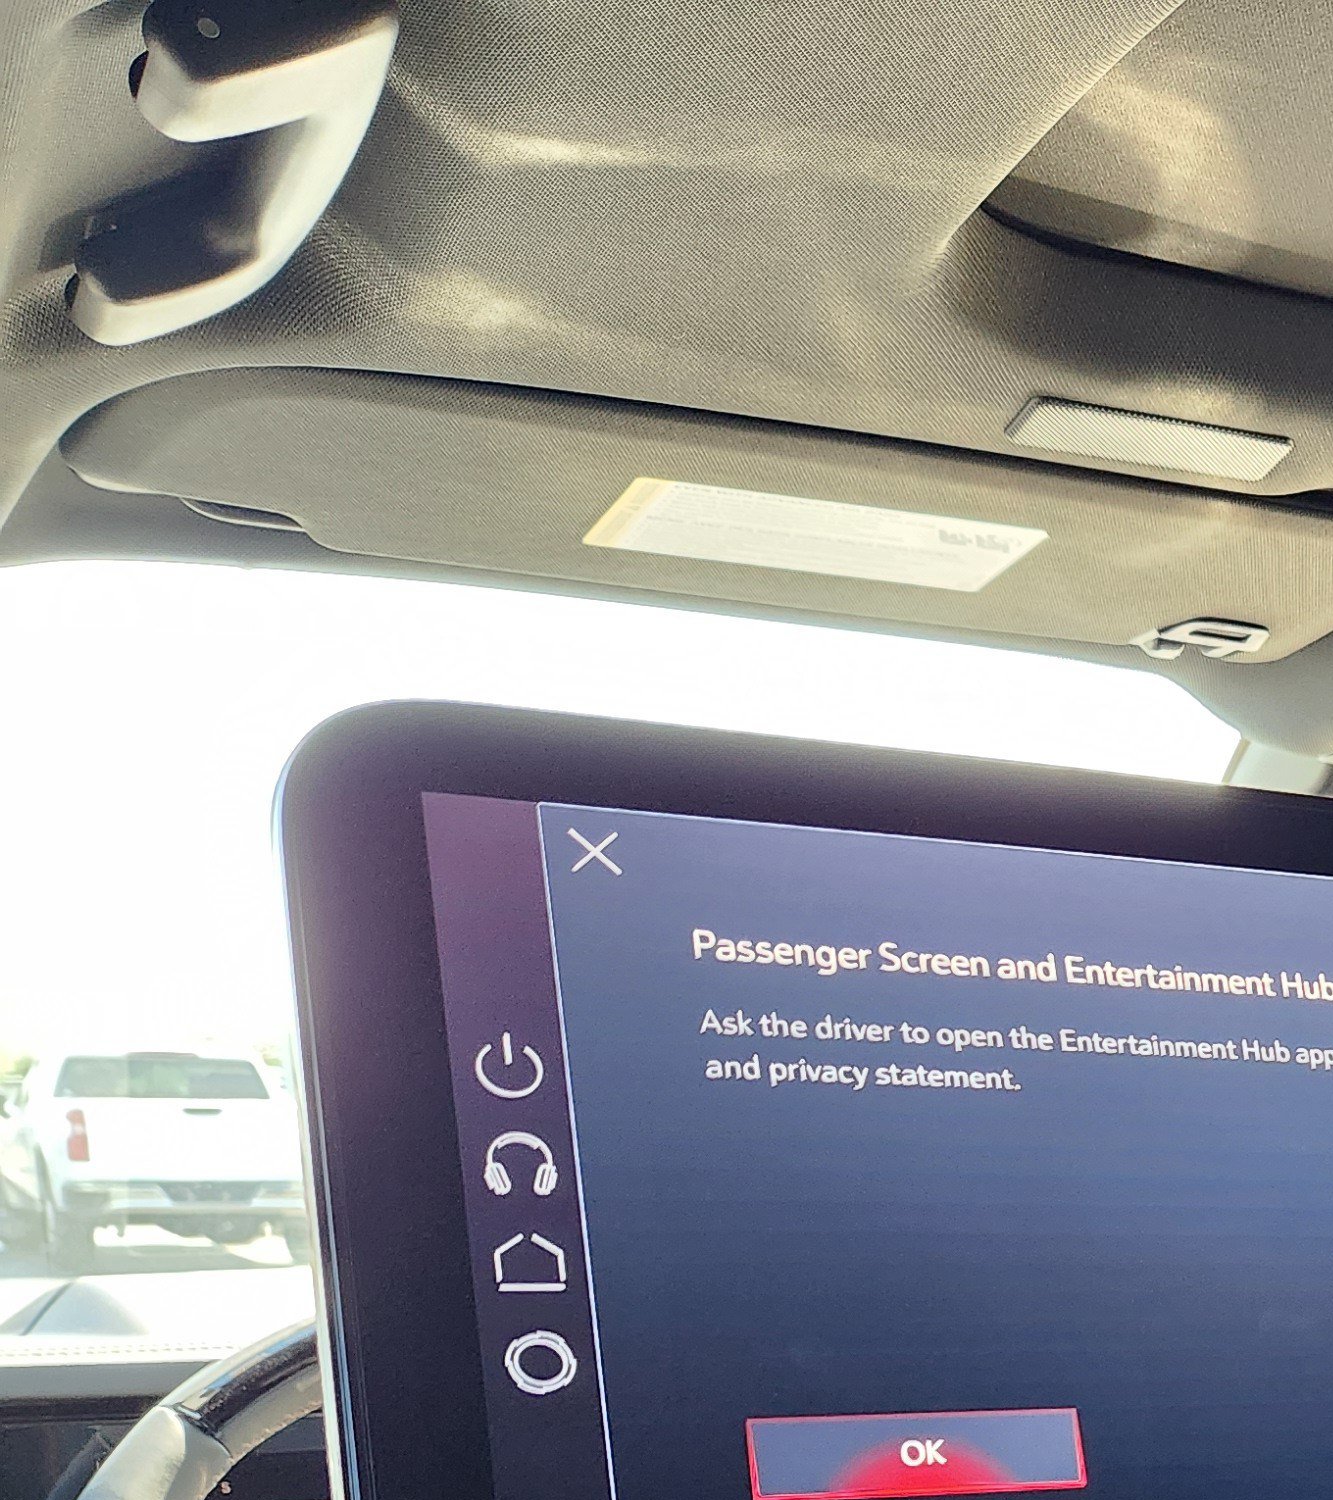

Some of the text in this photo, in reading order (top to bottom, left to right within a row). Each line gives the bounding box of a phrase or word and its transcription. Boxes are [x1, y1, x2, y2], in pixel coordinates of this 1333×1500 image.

[692, 928, 872, 976] Passenger
[878, 942, 991, 978] Screen
[996, 953, 1058, 982] and
[1064, 956, 1276, 996] Entertainment
[699, 1009, 755, 1036] Ask
[758, 1012, 808, 1039] the
[814, 1014, 895, 1043] driver
[899, 1022, 930, 1044] to
[936, 1026, 1004, 1052] open
[1008, 1026, 1053, 1051] the
[1060, 1029, 1239, 1062] Entertainment
[1242, 1039, 1291, 1063] Hub
[705, 1054, 1023, 1091] and privacy statement.
[900, 1438, 948, 1467] OK
